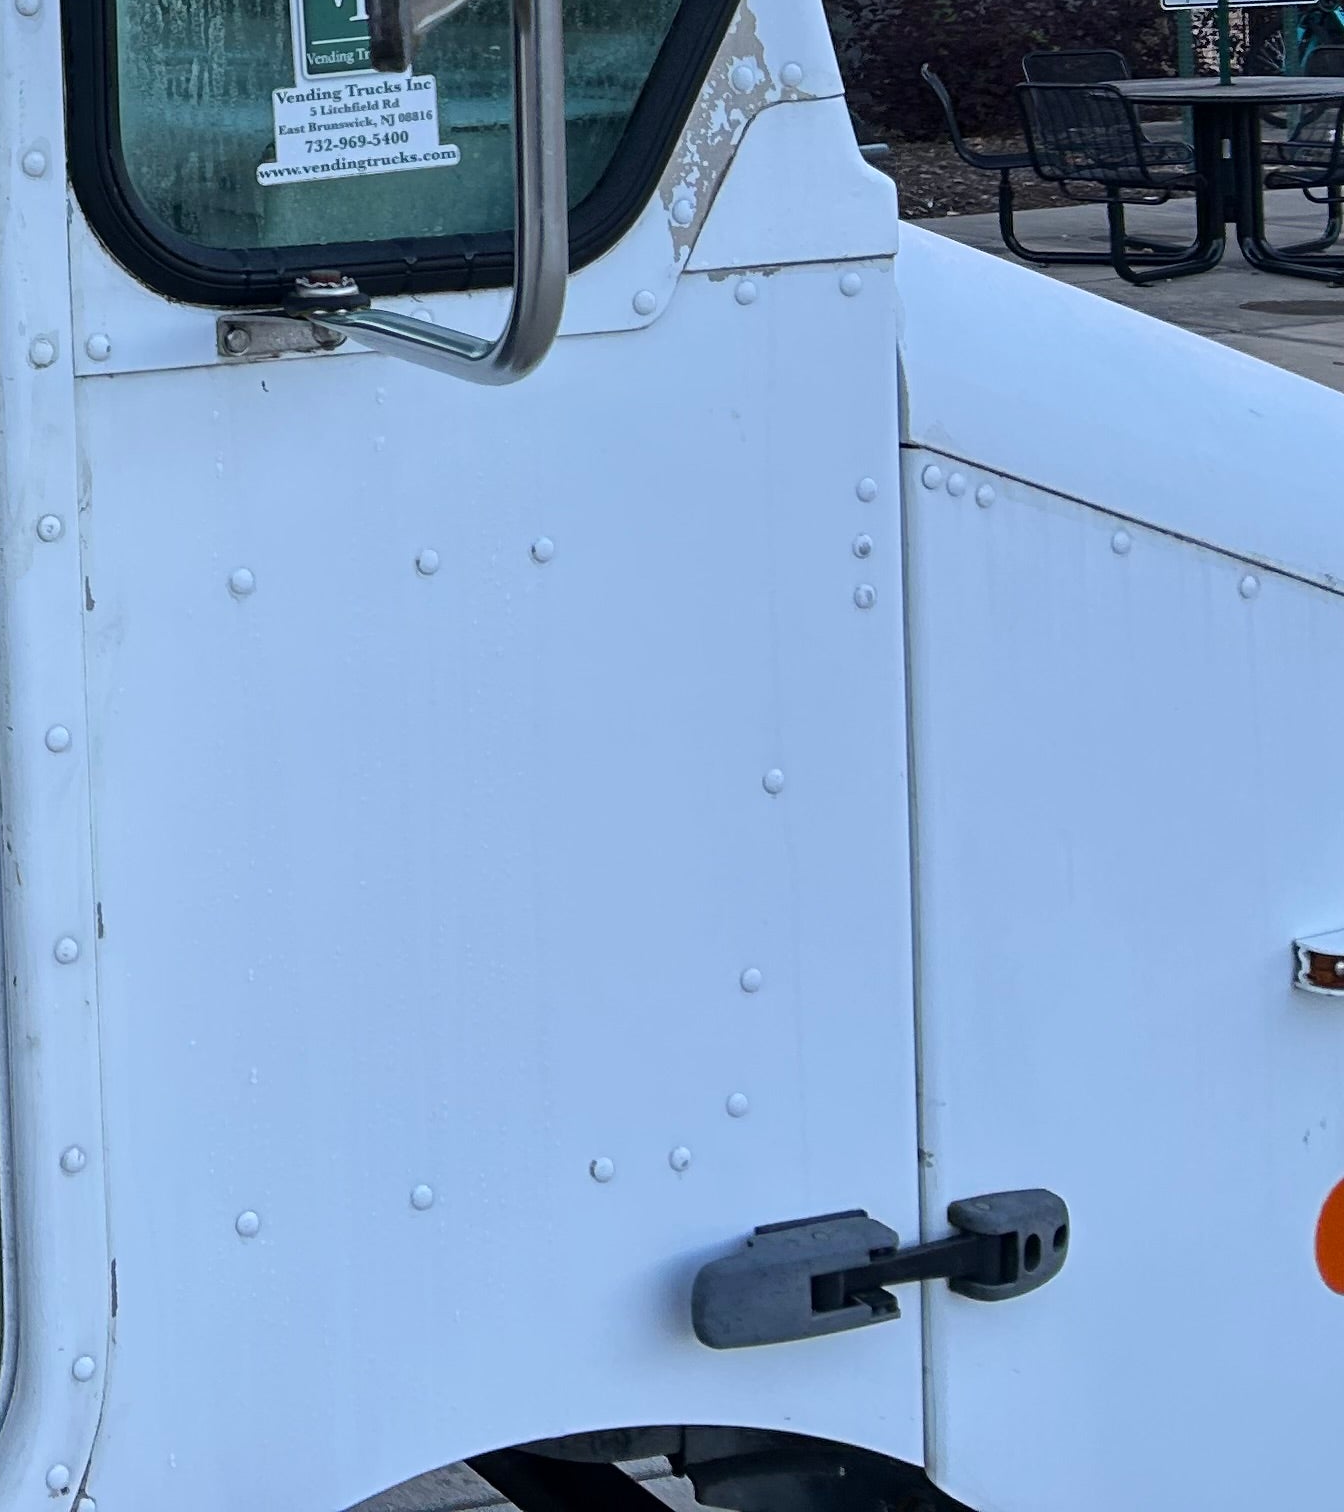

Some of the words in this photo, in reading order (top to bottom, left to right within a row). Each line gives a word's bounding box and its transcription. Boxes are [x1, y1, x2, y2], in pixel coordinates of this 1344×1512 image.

[307, 51, 354, 66] Vending
[276, 87, 342, 104] Vending
[346, 81, 401, 97] Trucks
[406, 78, 432, 92] Inc
[310, 106, 318, 117] 5
[320, 100, 379, 116] Litchfield
[382, 98, 400, 109] Rd
[278, 125, 305, 136] East
[308, 117, 378, 133] Brunswick,
[380, 114, 395, 127] NJ
[305, 131, 409, 153] 732-969-5400
[259, 150, 457, 179] www.vendingtrucks.com
